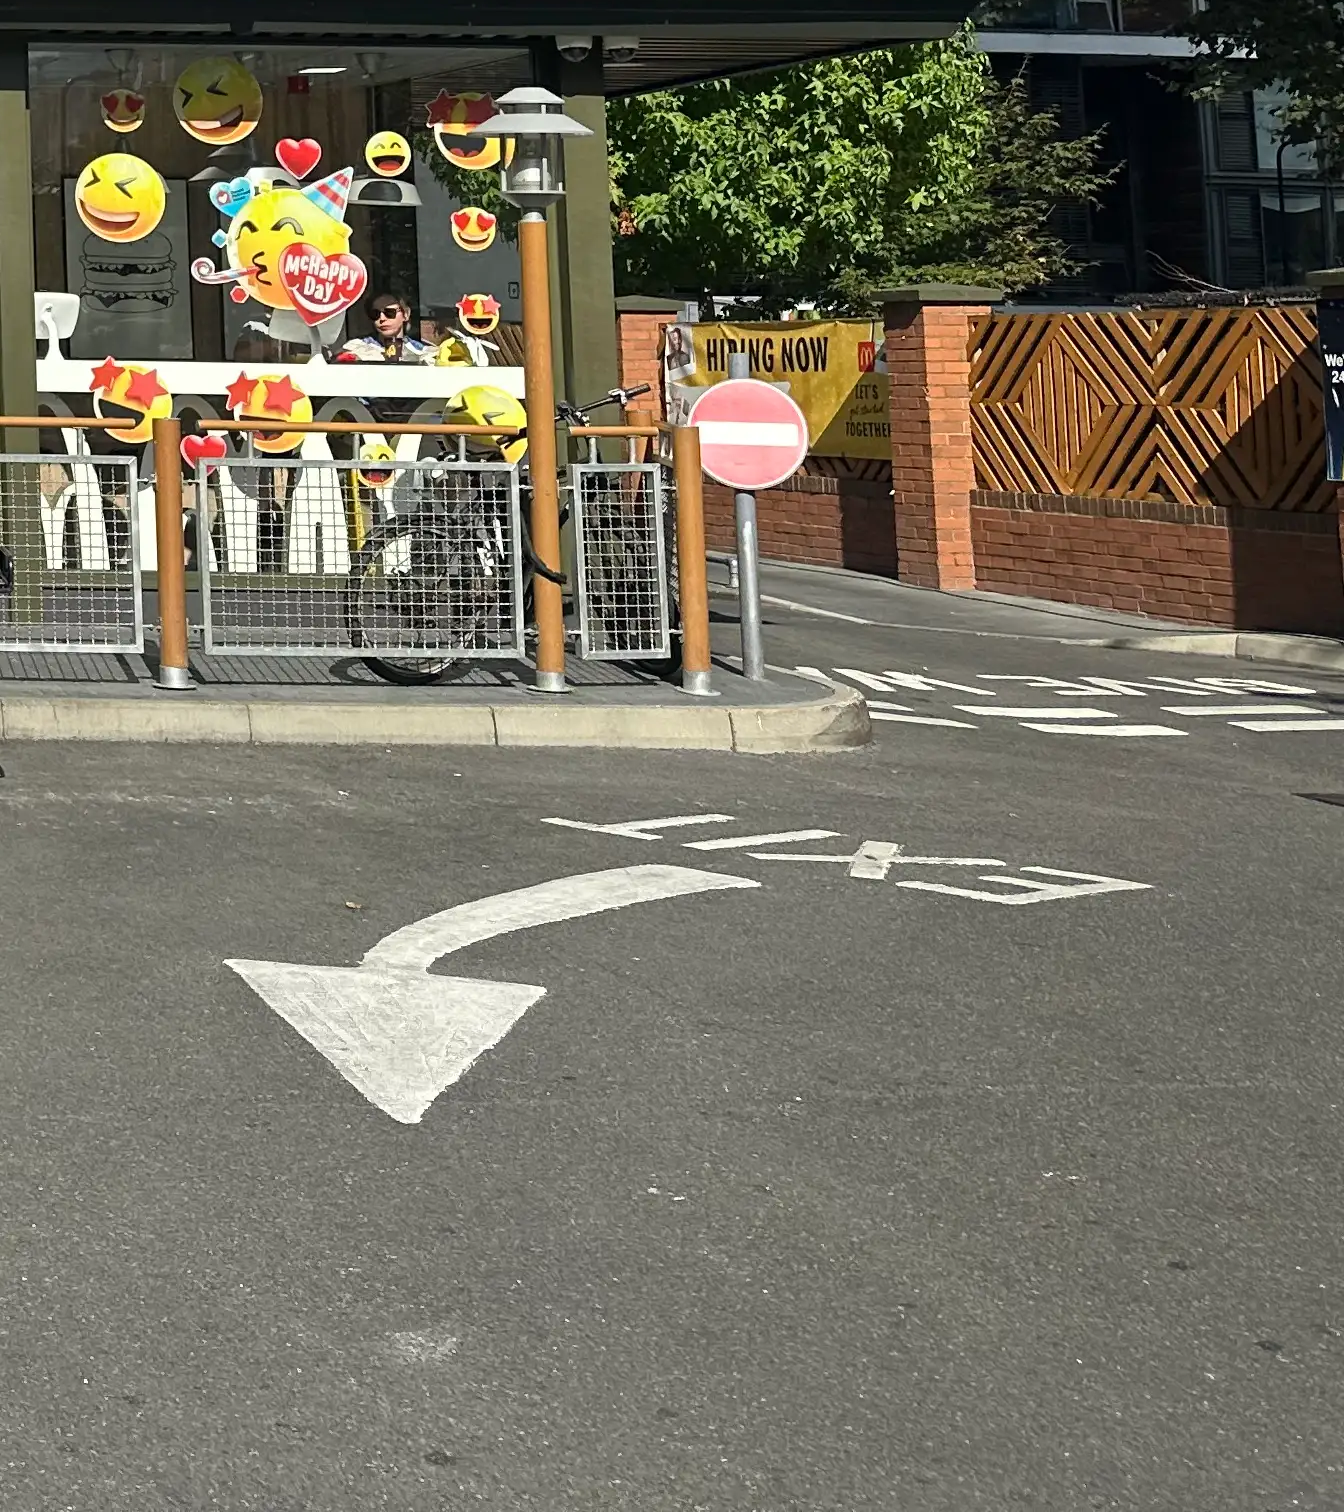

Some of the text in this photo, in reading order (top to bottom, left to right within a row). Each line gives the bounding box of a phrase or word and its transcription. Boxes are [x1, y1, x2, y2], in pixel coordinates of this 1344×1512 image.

[284, 254, 359, 290] McHappy
[303, 276, 335, 302] Day
[781, 337, 828, 373] NOW
[854, 383, 879, 400] LET'S
[976, 673, 1317, 697] GIVE
[540, 813, 1155, 905] EXIT
